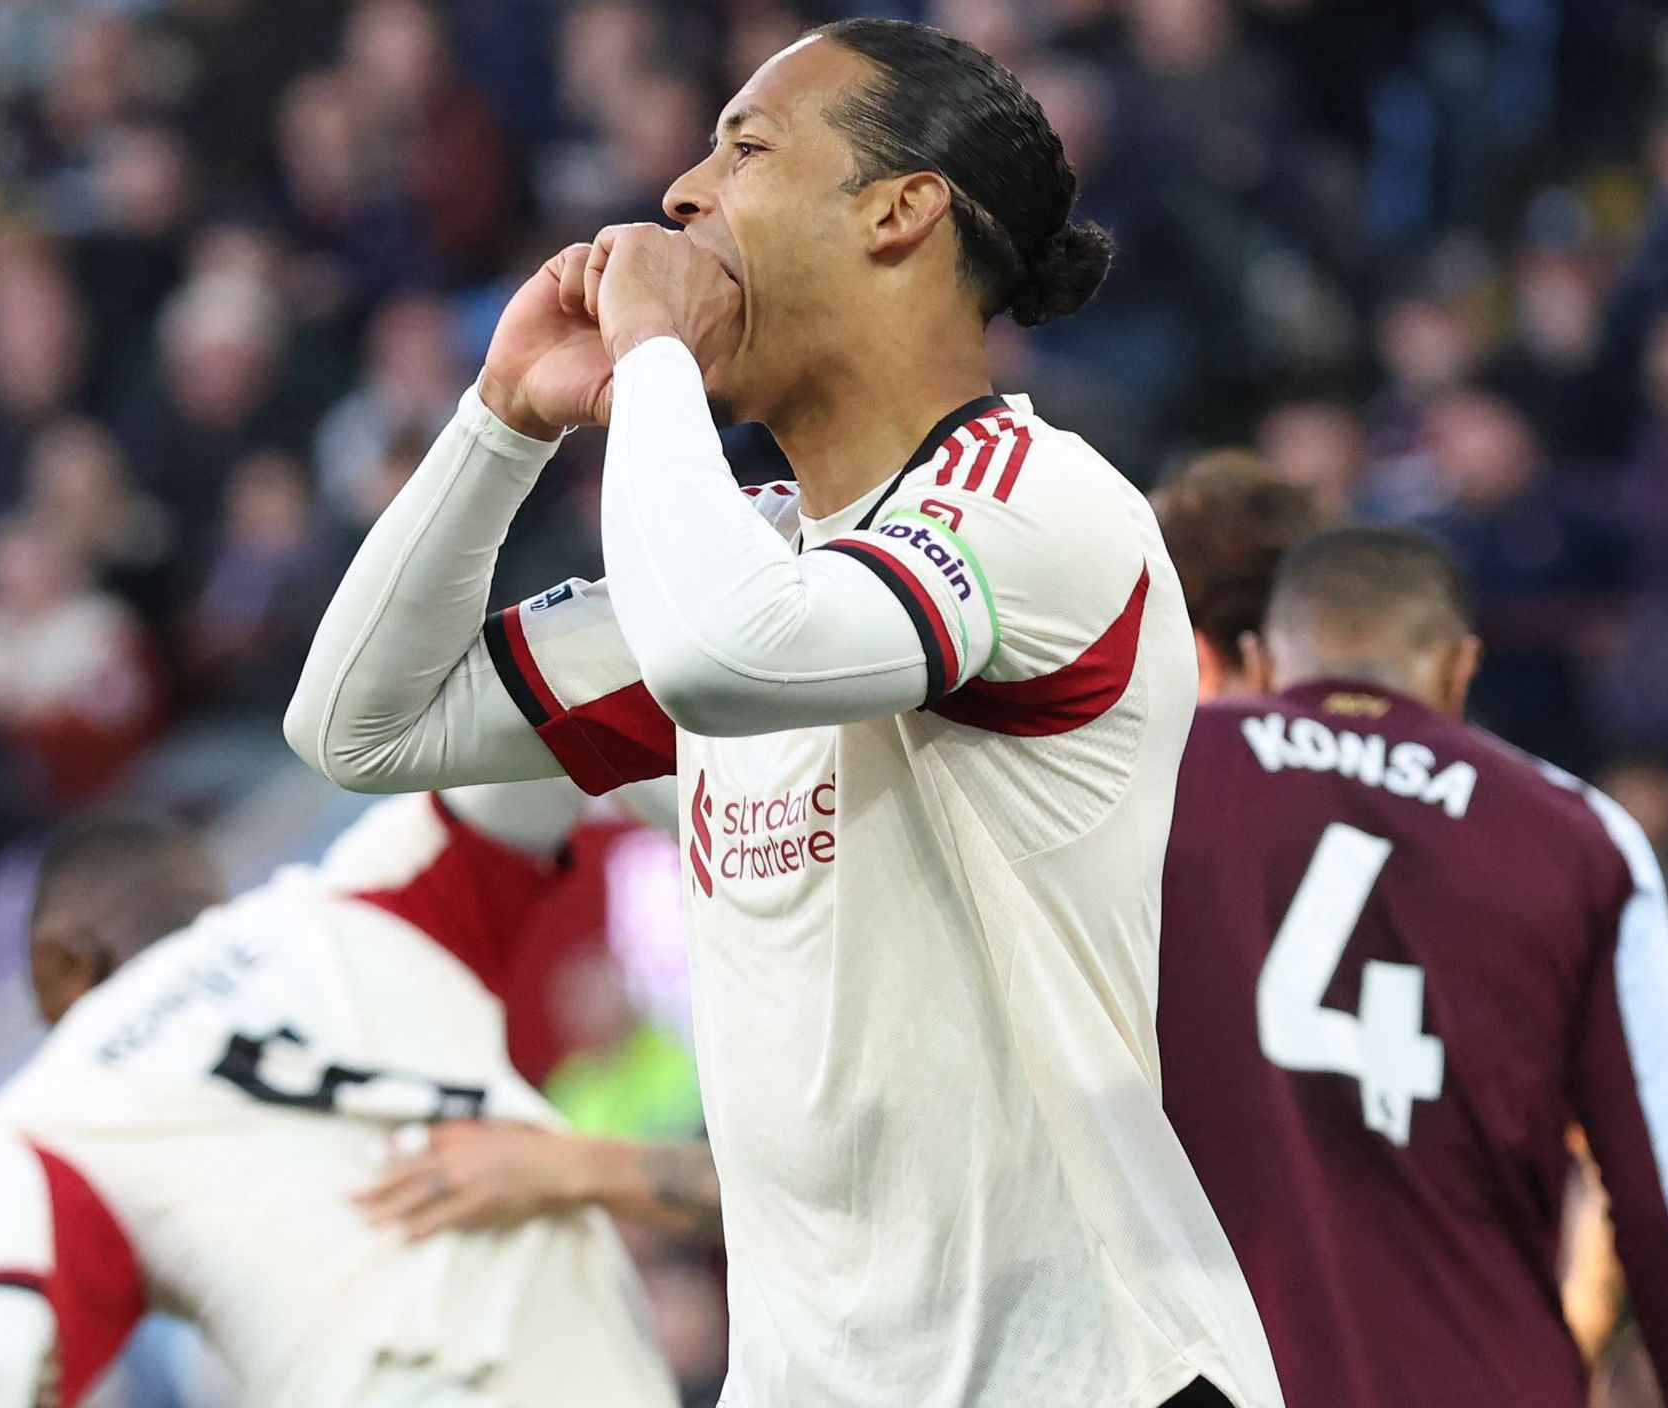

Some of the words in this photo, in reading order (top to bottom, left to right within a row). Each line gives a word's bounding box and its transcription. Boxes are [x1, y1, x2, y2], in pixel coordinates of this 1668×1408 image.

[878, 524, 972, 602] ptain
[1241, 711, 1478, 820] KONSA
[720, 830, 836, 880] chartere
[1257, 822, 1444, 1148] 4
